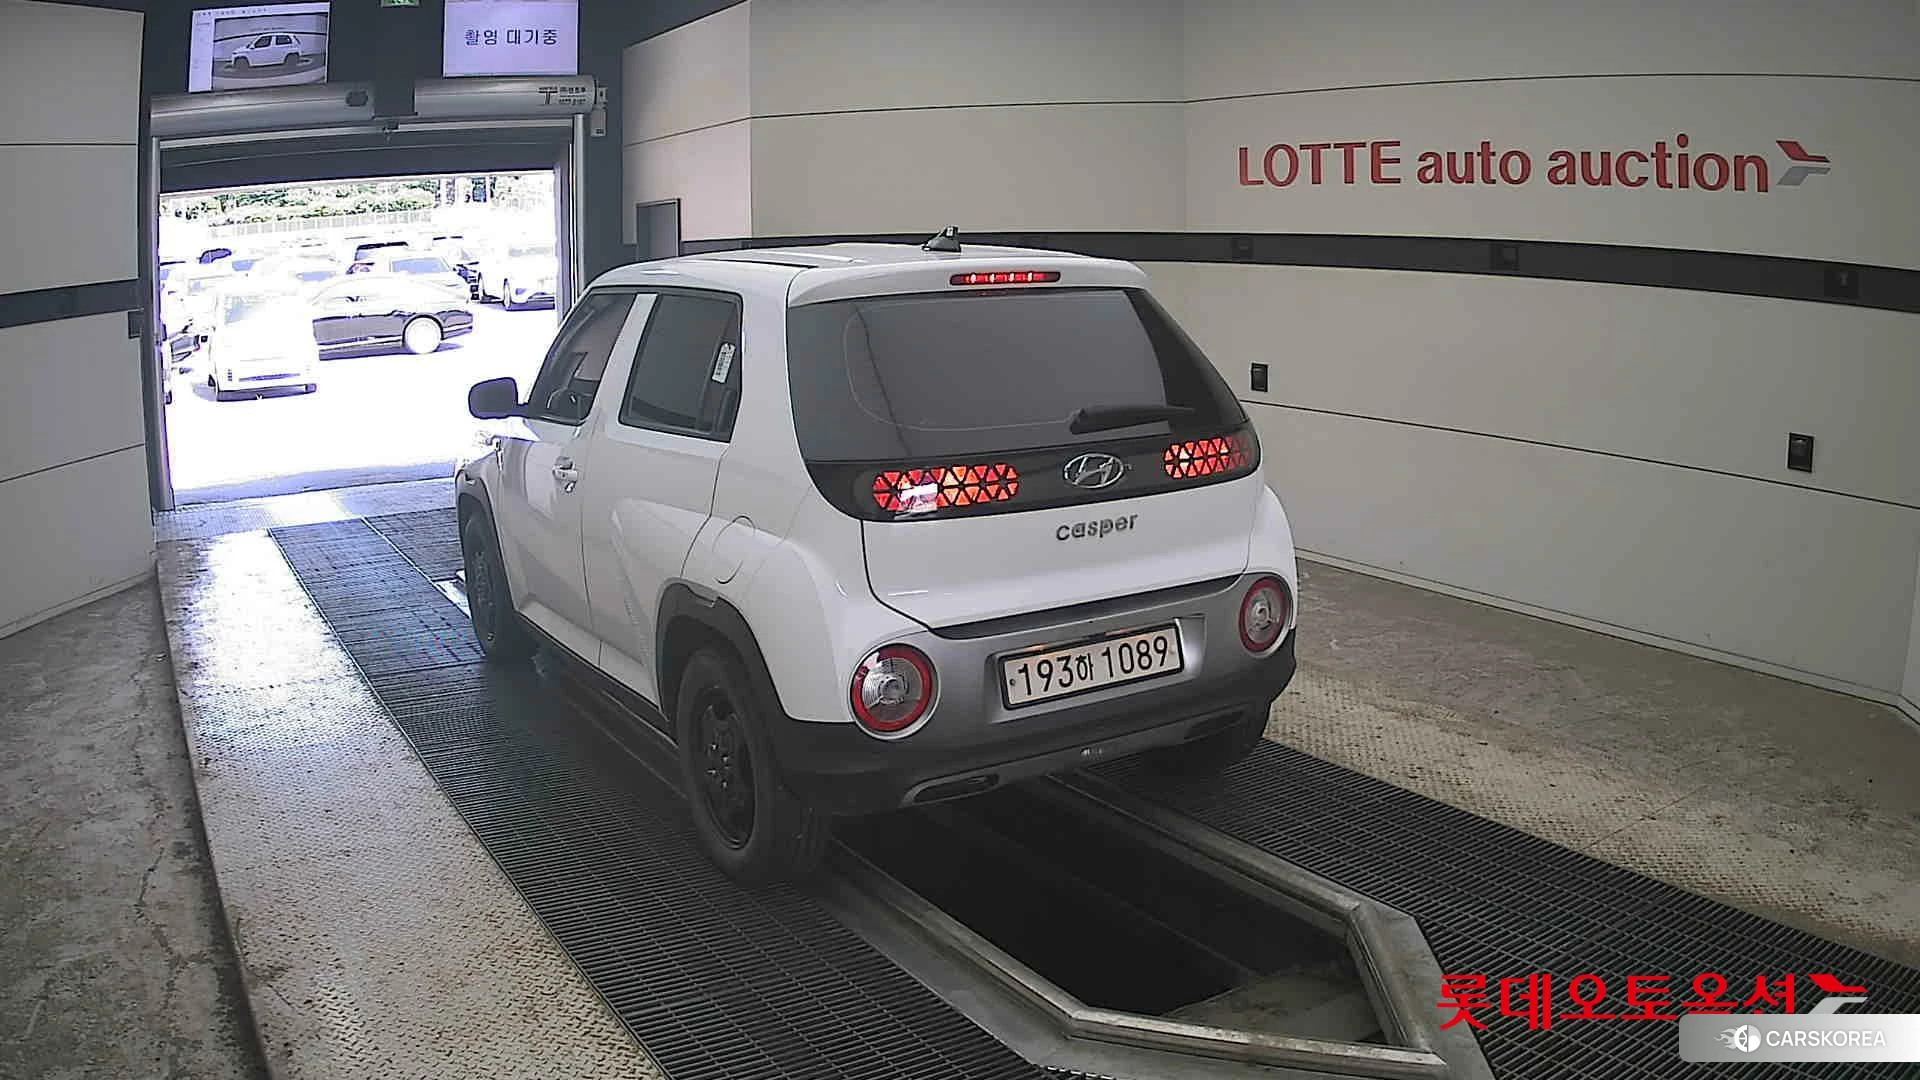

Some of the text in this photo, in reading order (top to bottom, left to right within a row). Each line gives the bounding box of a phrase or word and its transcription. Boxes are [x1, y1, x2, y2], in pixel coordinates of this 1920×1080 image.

[506, 29, 558, 46] 대기중
[1238, 133, 1769, 193] LOTTE auto auction
[1056, 513, 1139, 541] casper
[1018, 635, 1168, 696] 193하 1089
